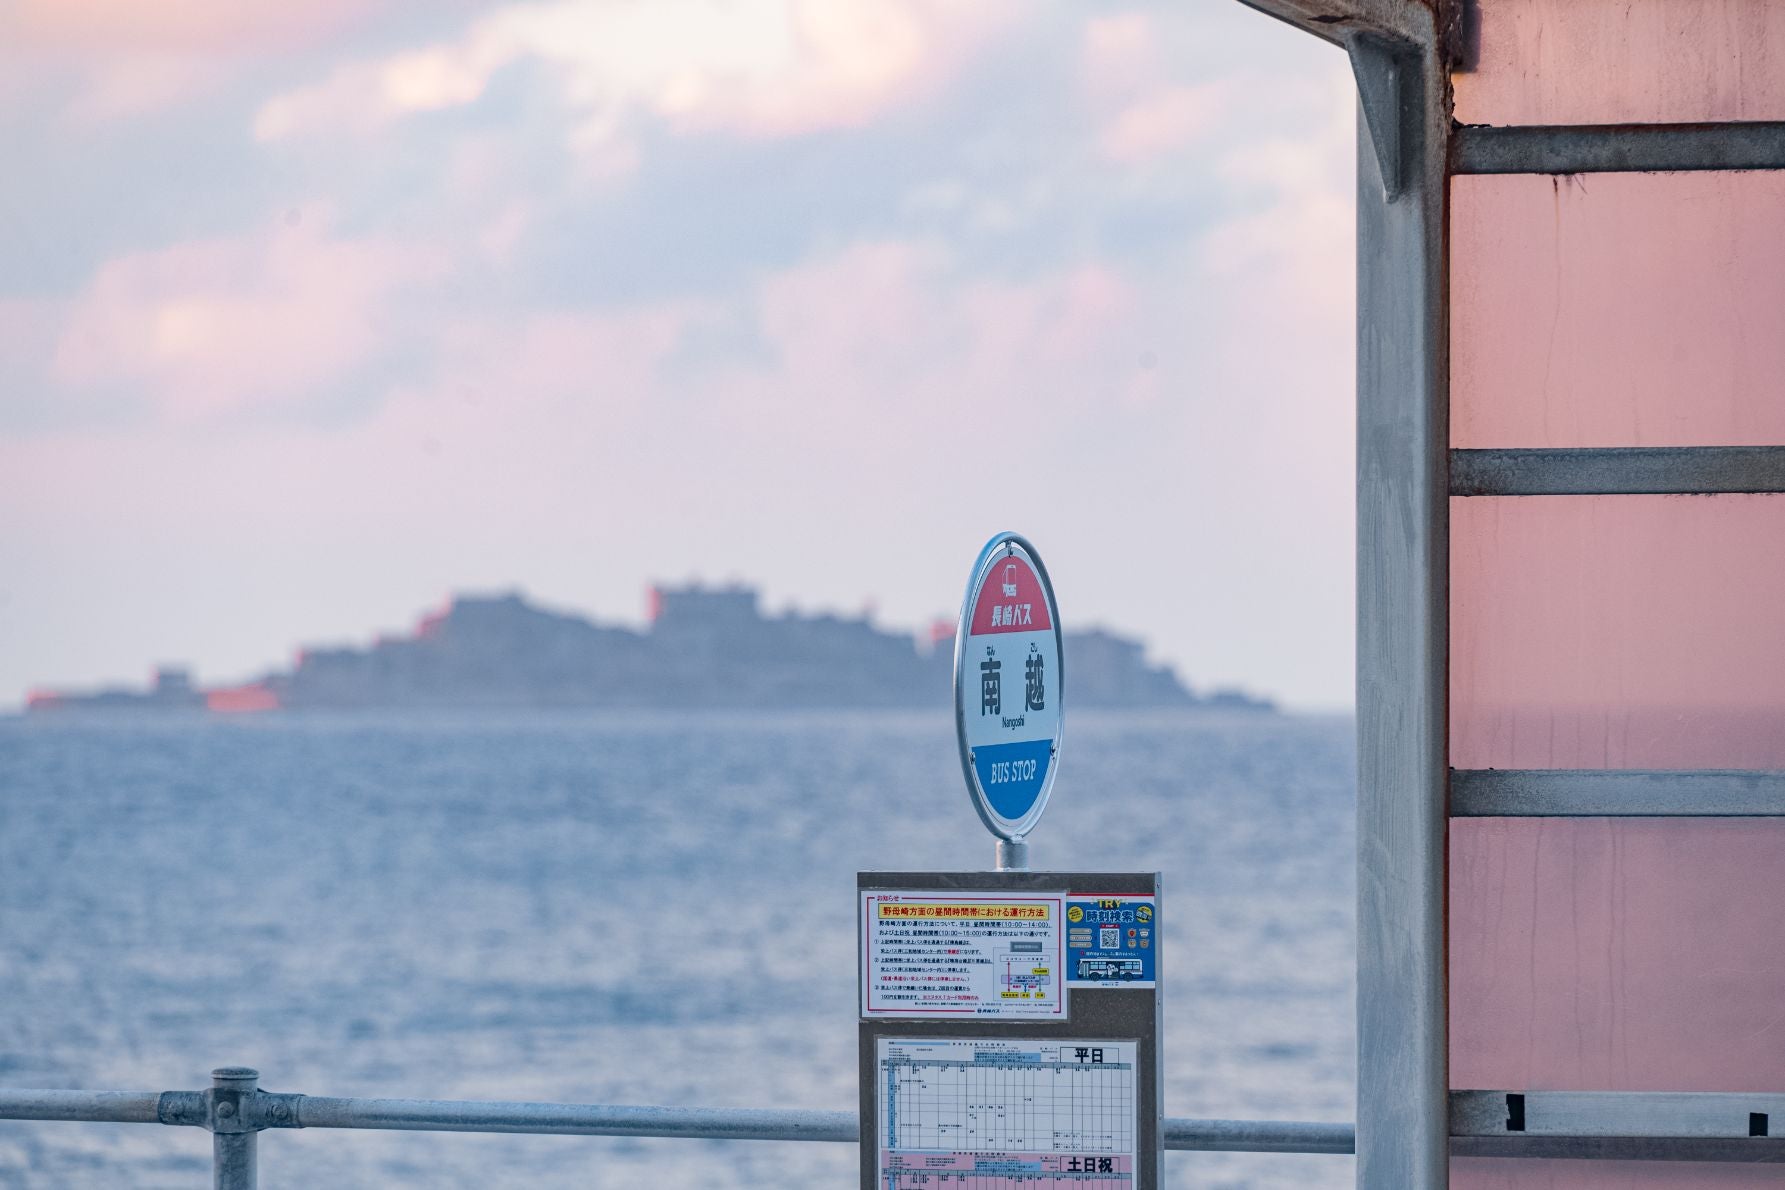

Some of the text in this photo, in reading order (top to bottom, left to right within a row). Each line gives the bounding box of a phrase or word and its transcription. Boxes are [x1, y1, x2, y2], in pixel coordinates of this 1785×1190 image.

[991, 603, 1032, 627] 長崎バス
[1002, 714, 1025, 730] Nangoshi
[991, 760, 1036, 784] BUS STOP
[883, 906, 1045, 917] 野母崎方面の昼間時間帯における運行方法
[1097, 899, 1121, 909] TRY
[1086, 909, 1135, 923] 時刻検索
[1075, 1047, 1104, 1064] 平日
[1067, 1156, 1113, 1174] 土日祝
